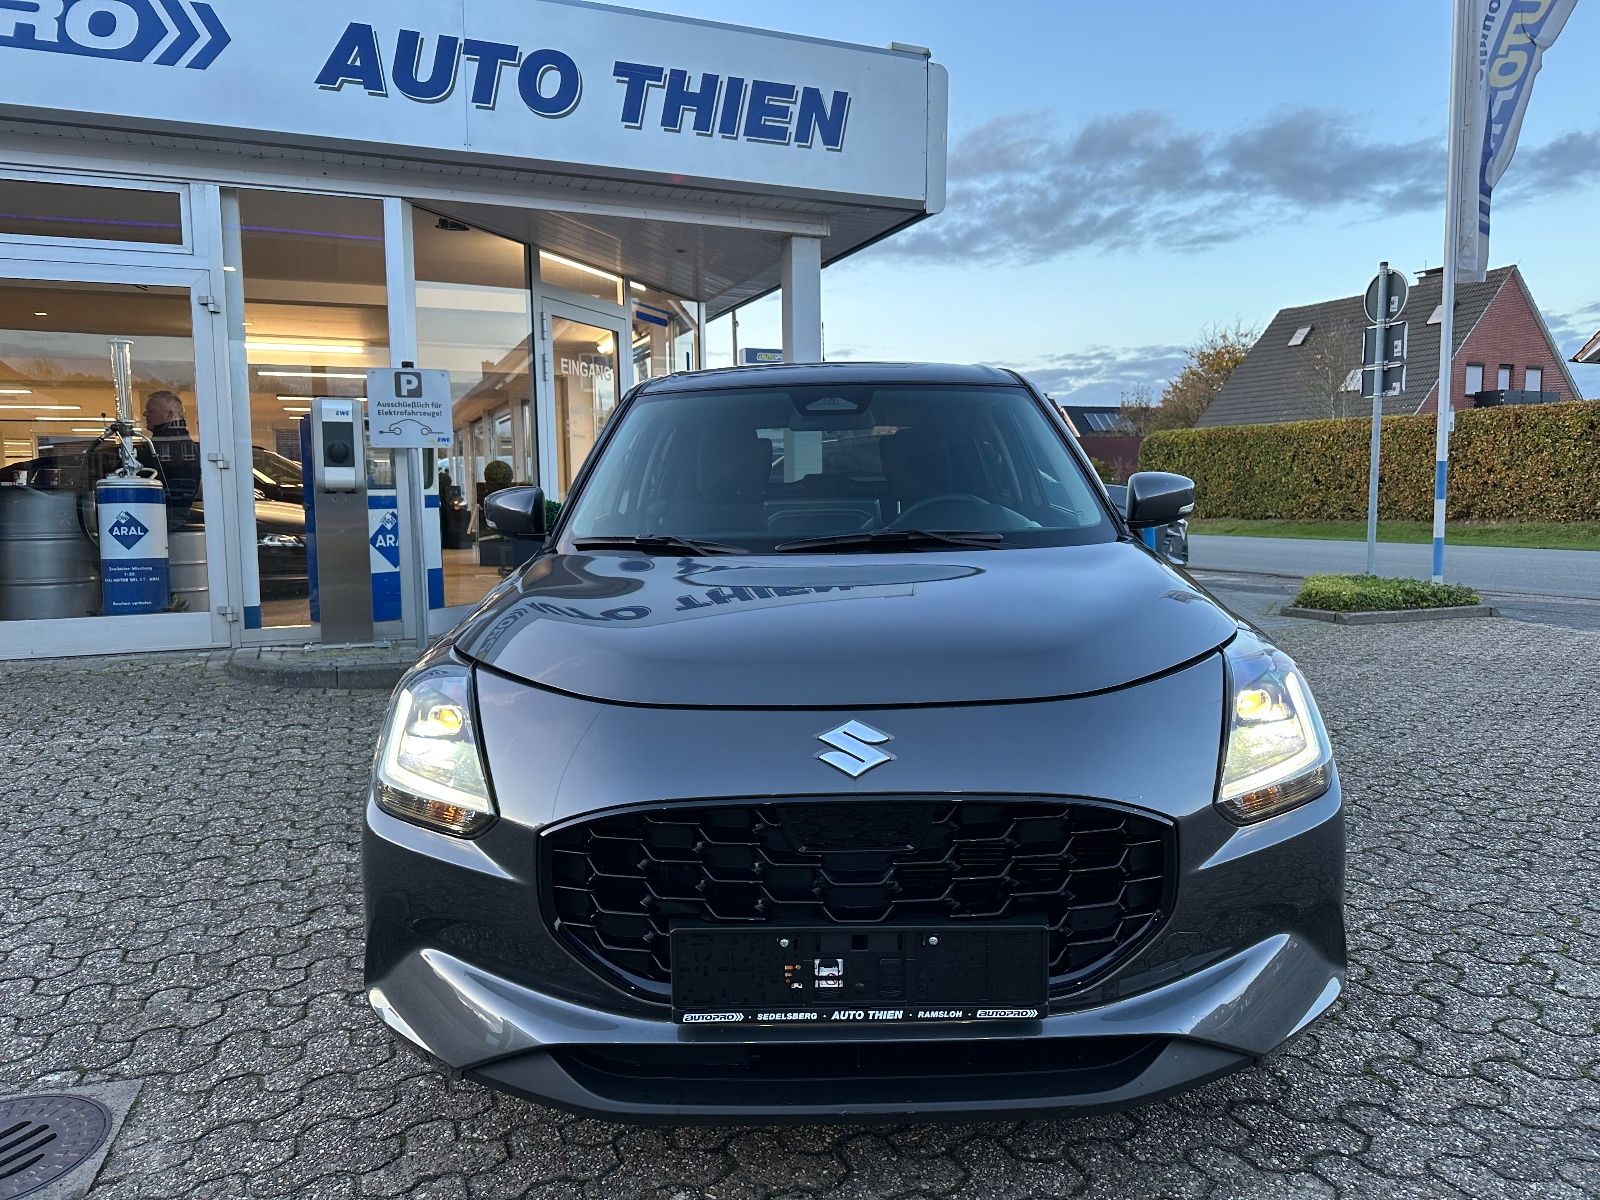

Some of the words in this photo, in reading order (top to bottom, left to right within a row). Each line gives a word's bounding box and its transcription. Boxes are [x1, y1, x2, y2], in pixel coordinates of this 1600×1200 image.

[314, 22, 584, 119] AUTO
[612, 60, 852, 152] THIEN
[560, 357, 613, 380] EINGANG
[400, 374, 418, 396] P
[376, 401, 429, 409] Ausschließlich
[377, 409, 442, 417] Elektrofahrzeuge!
[112, 526, 144, 536] ARAL
[375, 534, 399, 547] AR
[756, 1012, 818, 1021] SEDELSBERG
[831, 1010, 865, 1021] AUTO
[867, 1010, 903, 1020] THIEN
[918, 1010, 963, 1018] RAMSLOH
